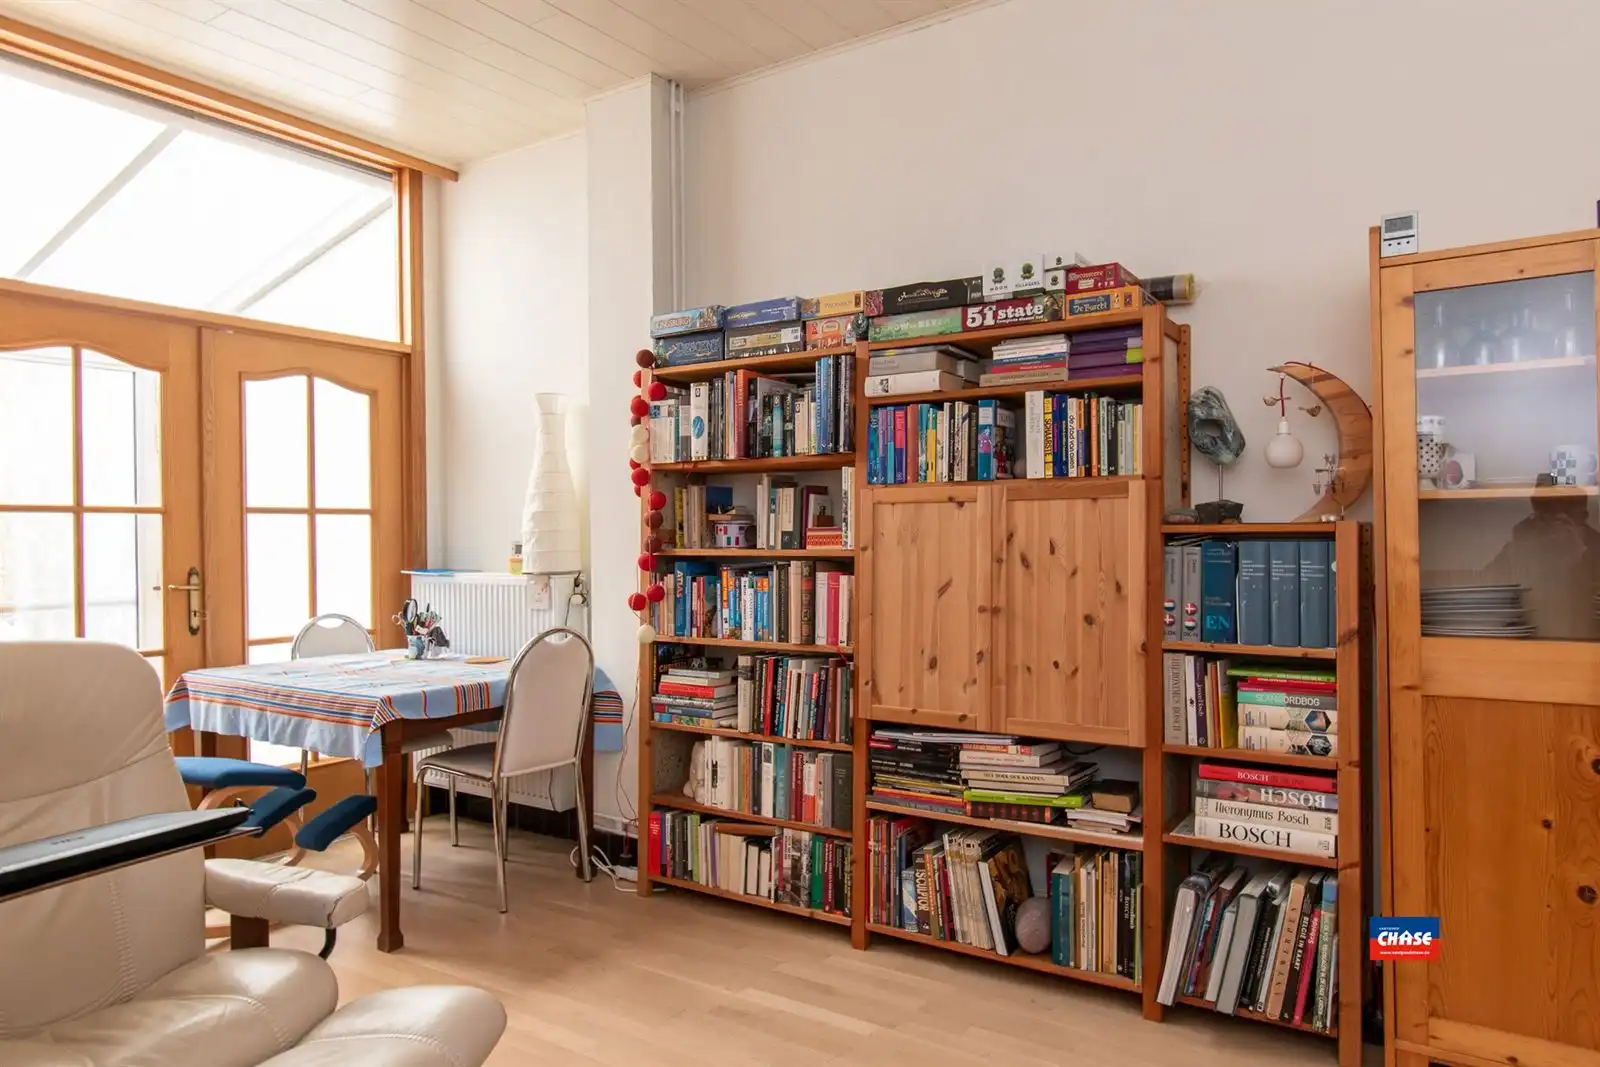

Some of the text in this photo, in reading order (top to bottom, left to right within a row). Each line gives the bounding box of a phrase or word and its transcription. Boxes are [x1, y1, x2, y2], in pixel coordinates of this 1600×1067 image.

[997, 302, 1044, 320] state
[1206, 614, 1230, 630] EN
[1238, 771, 1268, 781] BOSCH
[1260, 788, 1326, 808] BOSCH
[1215, 801, 1309, 826] Hieronymus Bosch
[1219, 823, 1292, 848] BOSCH
[916, 872, 929, 911] SCULPTOR
